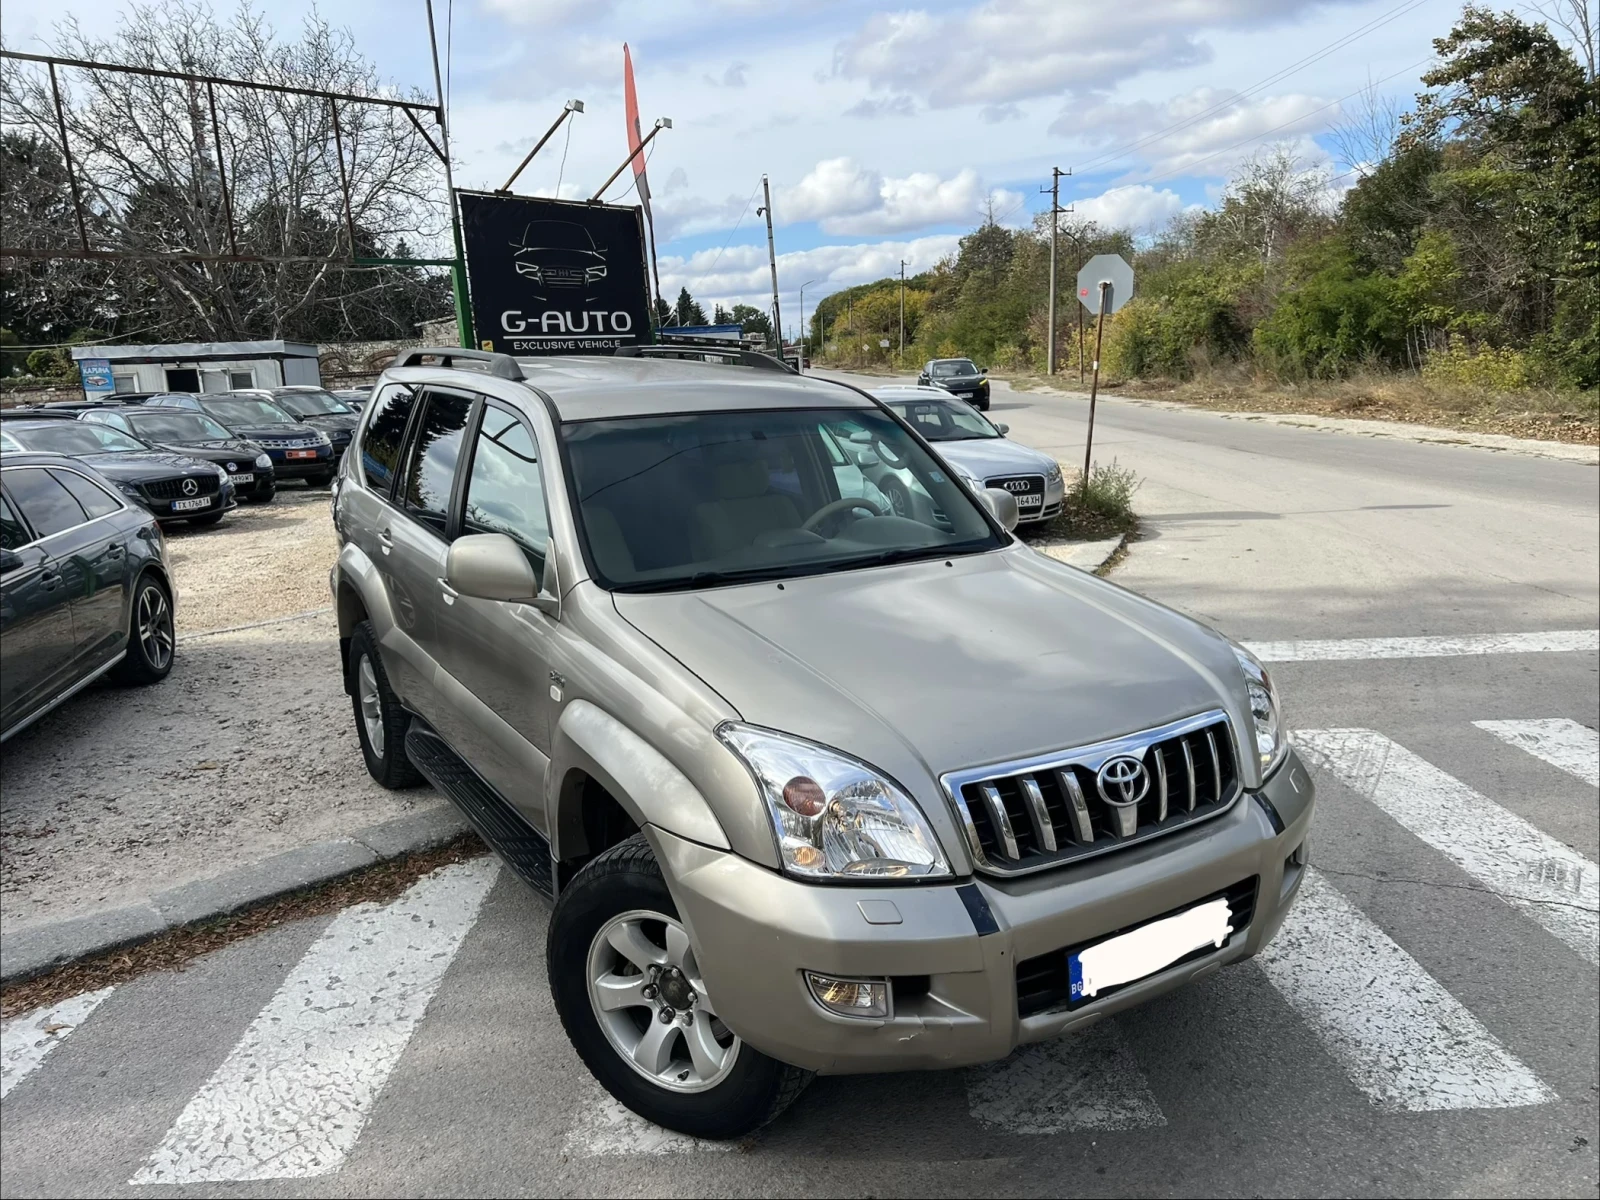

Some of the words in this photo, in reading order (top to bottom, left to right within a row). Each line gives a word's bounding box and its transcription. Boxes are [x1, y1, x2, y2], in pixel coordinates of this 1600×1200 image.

[500, 310, 632, 333] G-AUTO
[513, 341, 576, 350] EXCLUSIVE
[577, 339, 621, 349] VEHICLE
[1071, 981, 1083, 995] BG
